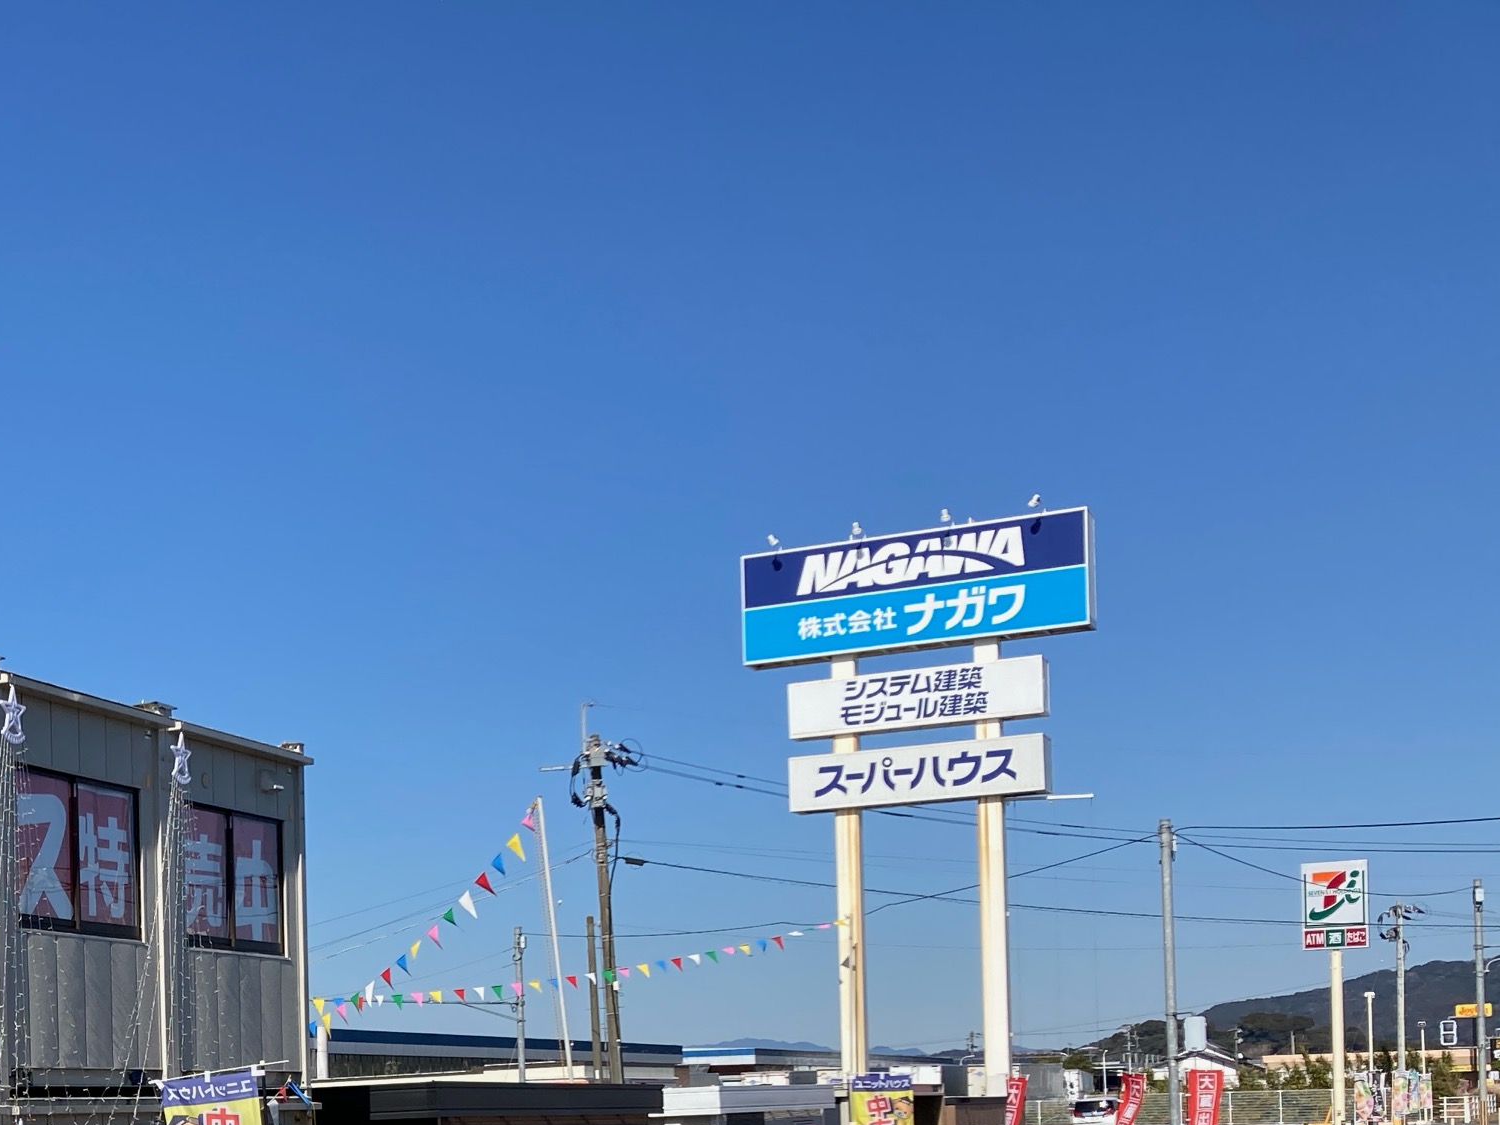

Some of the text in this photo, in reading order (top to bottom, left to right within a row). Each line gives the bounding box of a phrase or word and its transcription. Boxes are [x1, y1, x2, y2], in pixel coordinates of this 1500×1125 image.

[796, 526, 1026, 596] NAGAWA
[798, 584, 1026, 641] 株式会社 ナガワ
[843, 666, 985, 702] システム建築
[840, 690, 988, 726] モジュール建築
[813, 748, 1018, 799] スーパーハウス
[1306, 933, 1324, 946] ATM
[1329, 931, 1342, 945] 酒
[1347, 931, 1366, 943] たばこ
[854, 1078, 911, 1090] ユニットハウス
